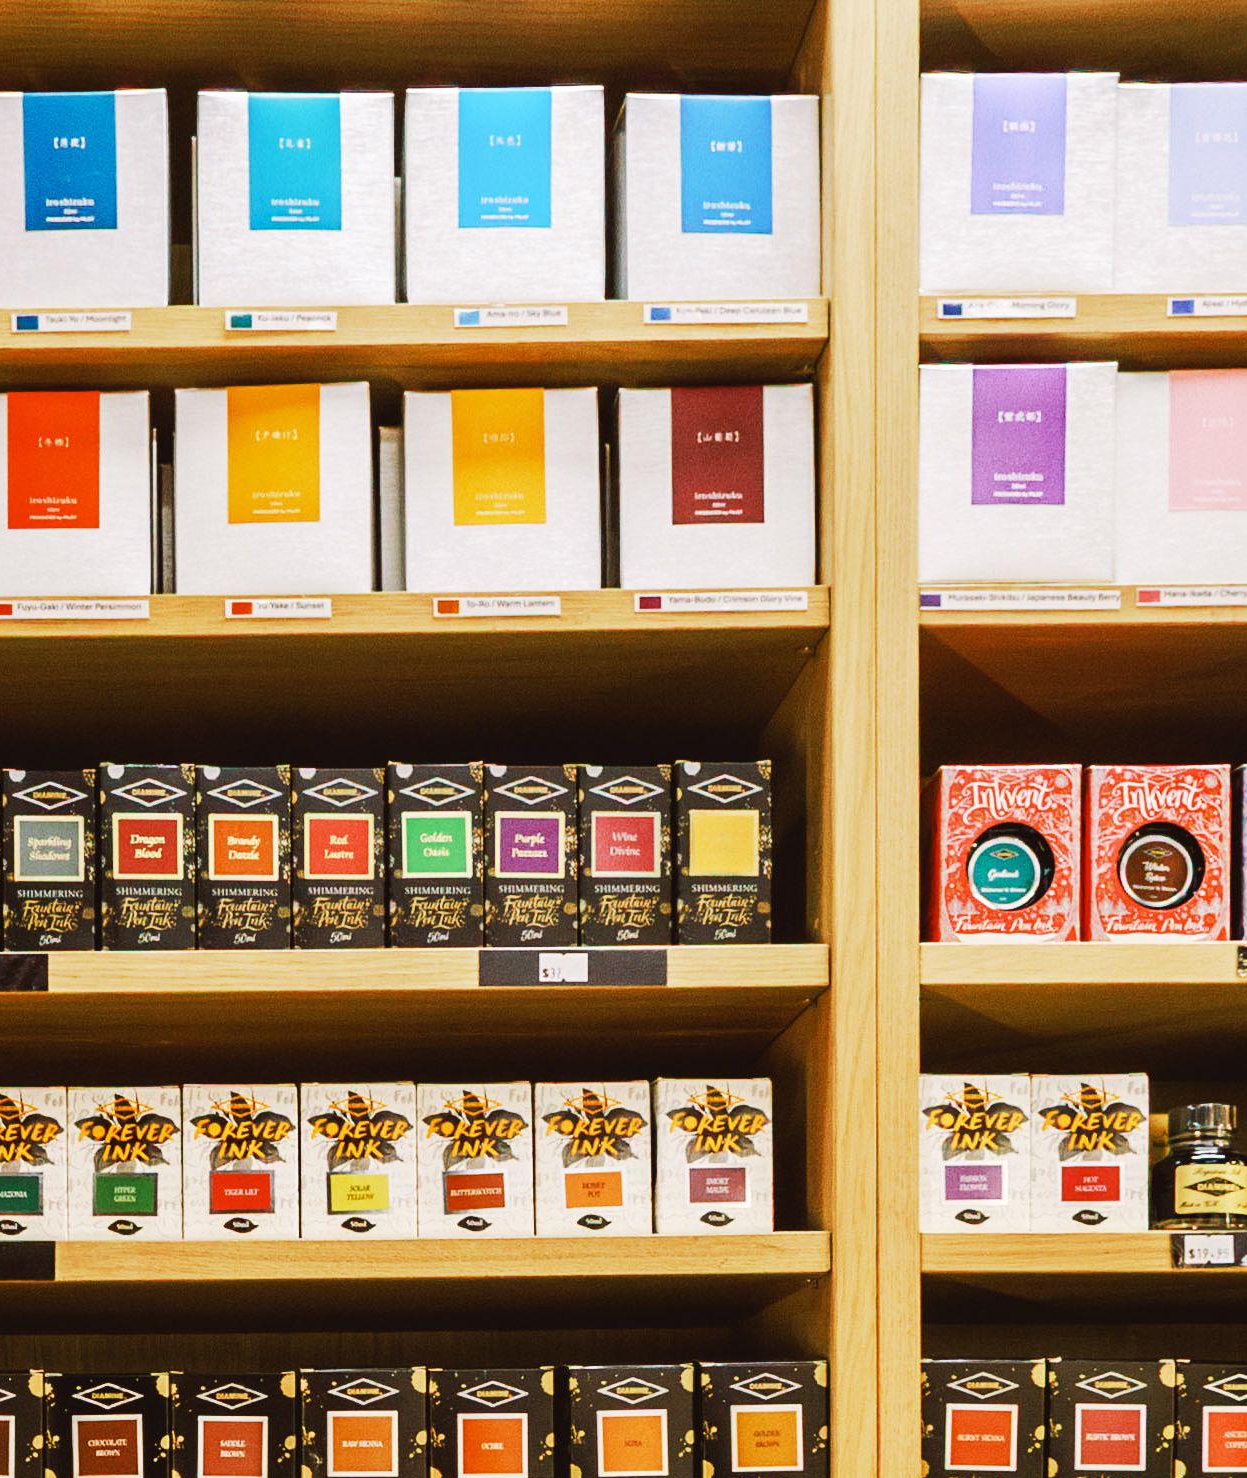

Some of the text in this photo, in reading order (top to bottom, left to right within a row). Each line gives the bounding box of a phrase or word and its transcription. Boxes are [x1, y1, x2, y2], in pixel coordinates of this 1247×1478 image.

[962, 783, 1054, 819] Inkvent
[1111, 783, 1203, 819] Inkvent
[130, 834, 165, 846] Dragon
[420, 833, 452, 844] Golden
[515, 833, 545, 845] Purple
[135, 847, 162, 858] Blood
[116, 888, 182, 896] SHIMMERING
[954, 914, 1056, 932] Fountain Pen Ink
[546, 1119, 647, 1137] FOREVER
[1042, 1110, 1142, 1132] FOREVER
[571, 1138, 617, 1155] INK
[1068, 1132, 1115, 1151] INK
[88, 1438, 127, 1446] CHOCOLATE
